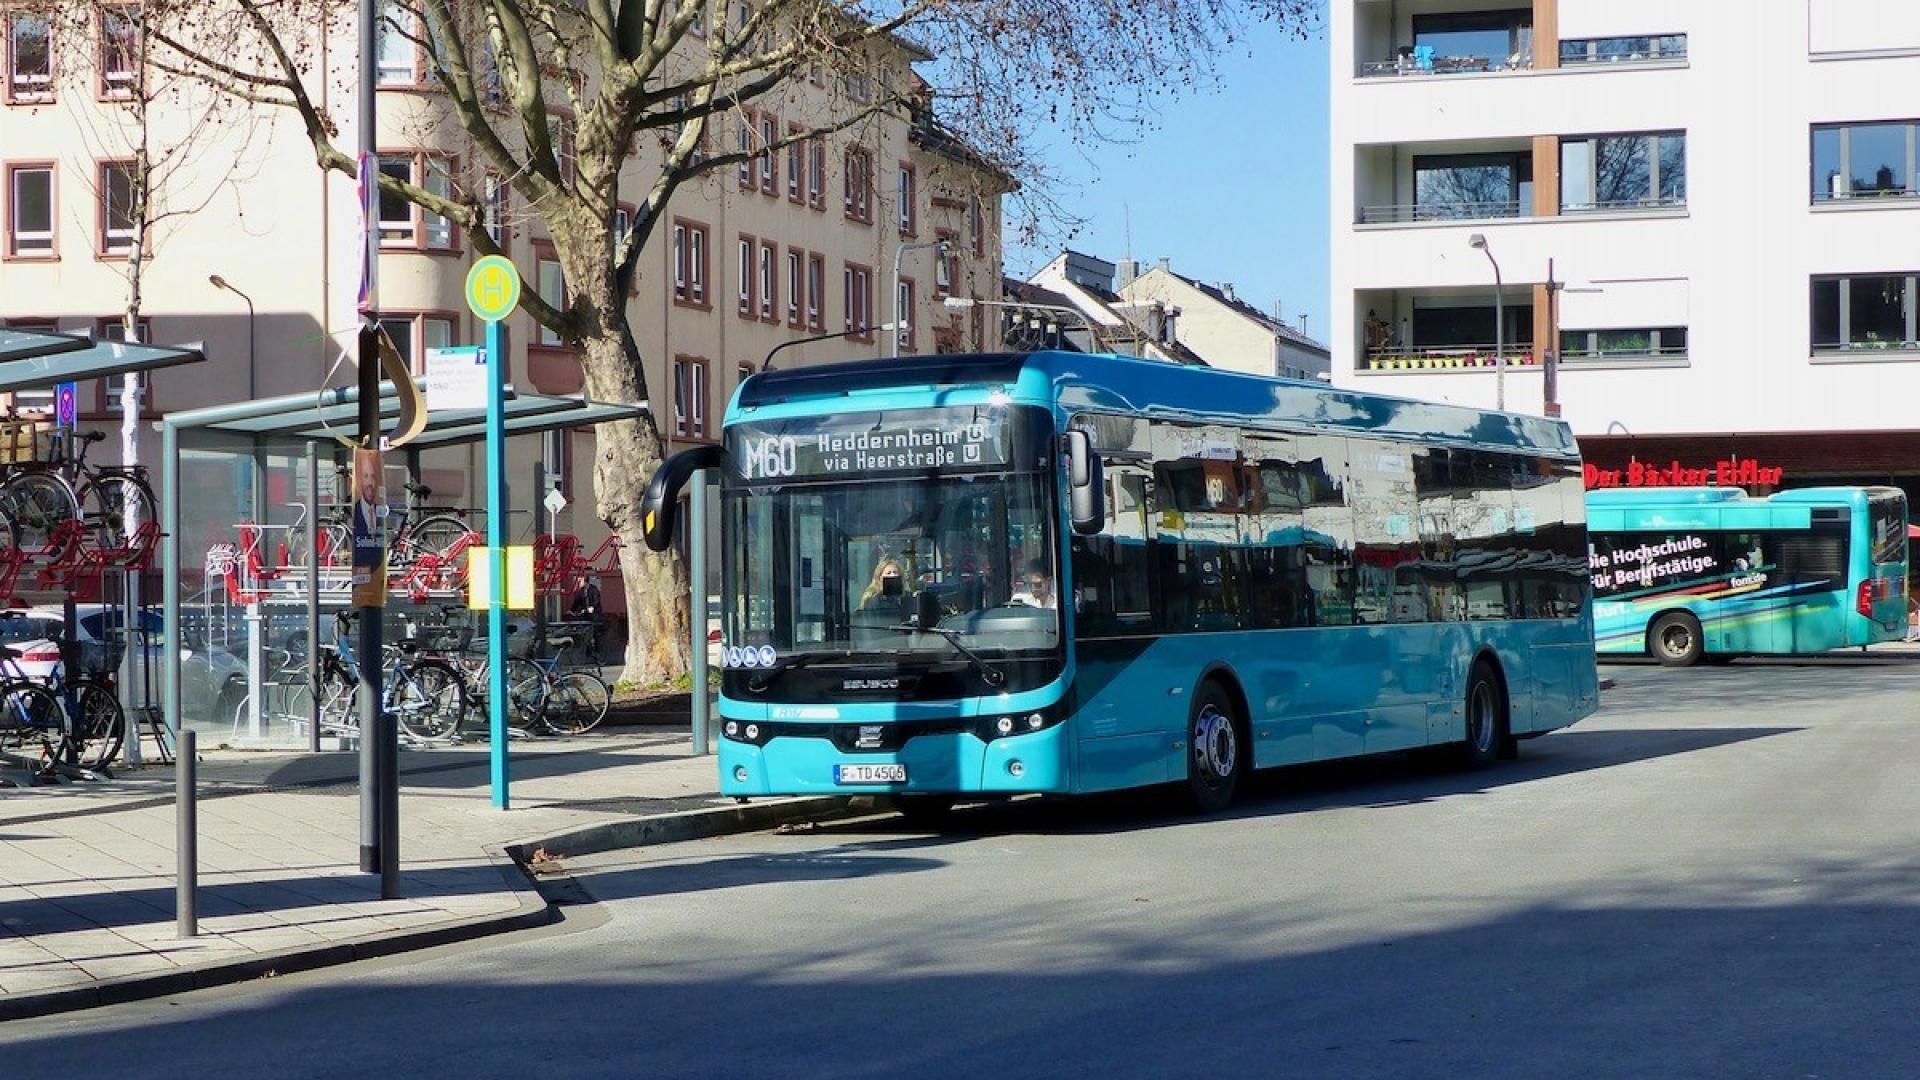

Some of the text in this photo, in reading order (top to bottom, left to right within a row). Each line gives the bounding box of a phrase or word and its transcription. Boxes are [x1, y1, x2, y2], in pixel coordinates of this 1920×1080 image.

[482, 270, 504, 306] H
[818, 427, 959, 453] Heddernheim
[745, 436, 797, 480] M60
[823, 453, 850, 471] via
[856, 446, 955, 470] Heerstraße
[1584, 458, 1784, 487] Der Bäcker Eifler
[1613, 536, 1707, 564] Hochschule.
[1615, 555, 1718, 586] Berufstätige.
[841, 766, 850, 780] F
